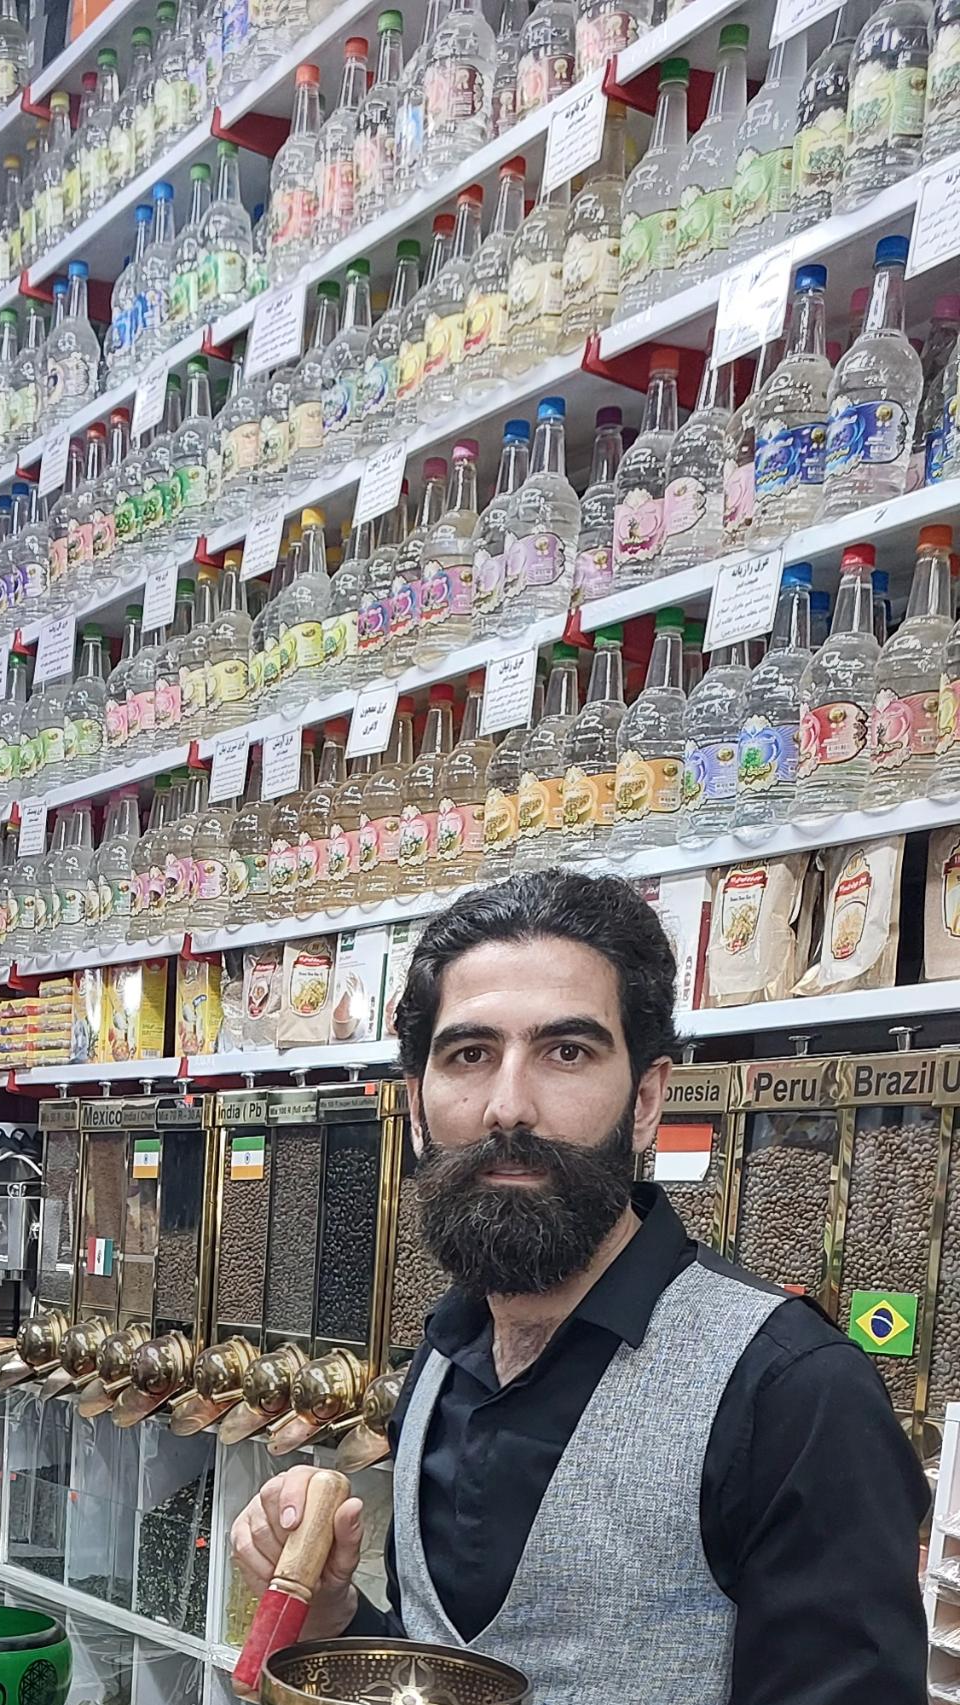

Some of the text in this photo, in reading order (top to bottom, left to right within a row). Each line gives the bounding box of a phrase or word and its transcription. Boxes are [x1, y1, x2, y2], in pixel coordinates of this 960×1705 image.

[732, 556, 770, 578] عرق رازیانه
[754, 1072, 817, 1102] Peru
[853, 1060, 936, 1098] Brazil
[664, 1079, 720, 1103] onesia
[83, 1105, 122, 1126] Mexico
[218, 1104, 240, 1120] India
[249, 1103, 261, 1118] Pb
